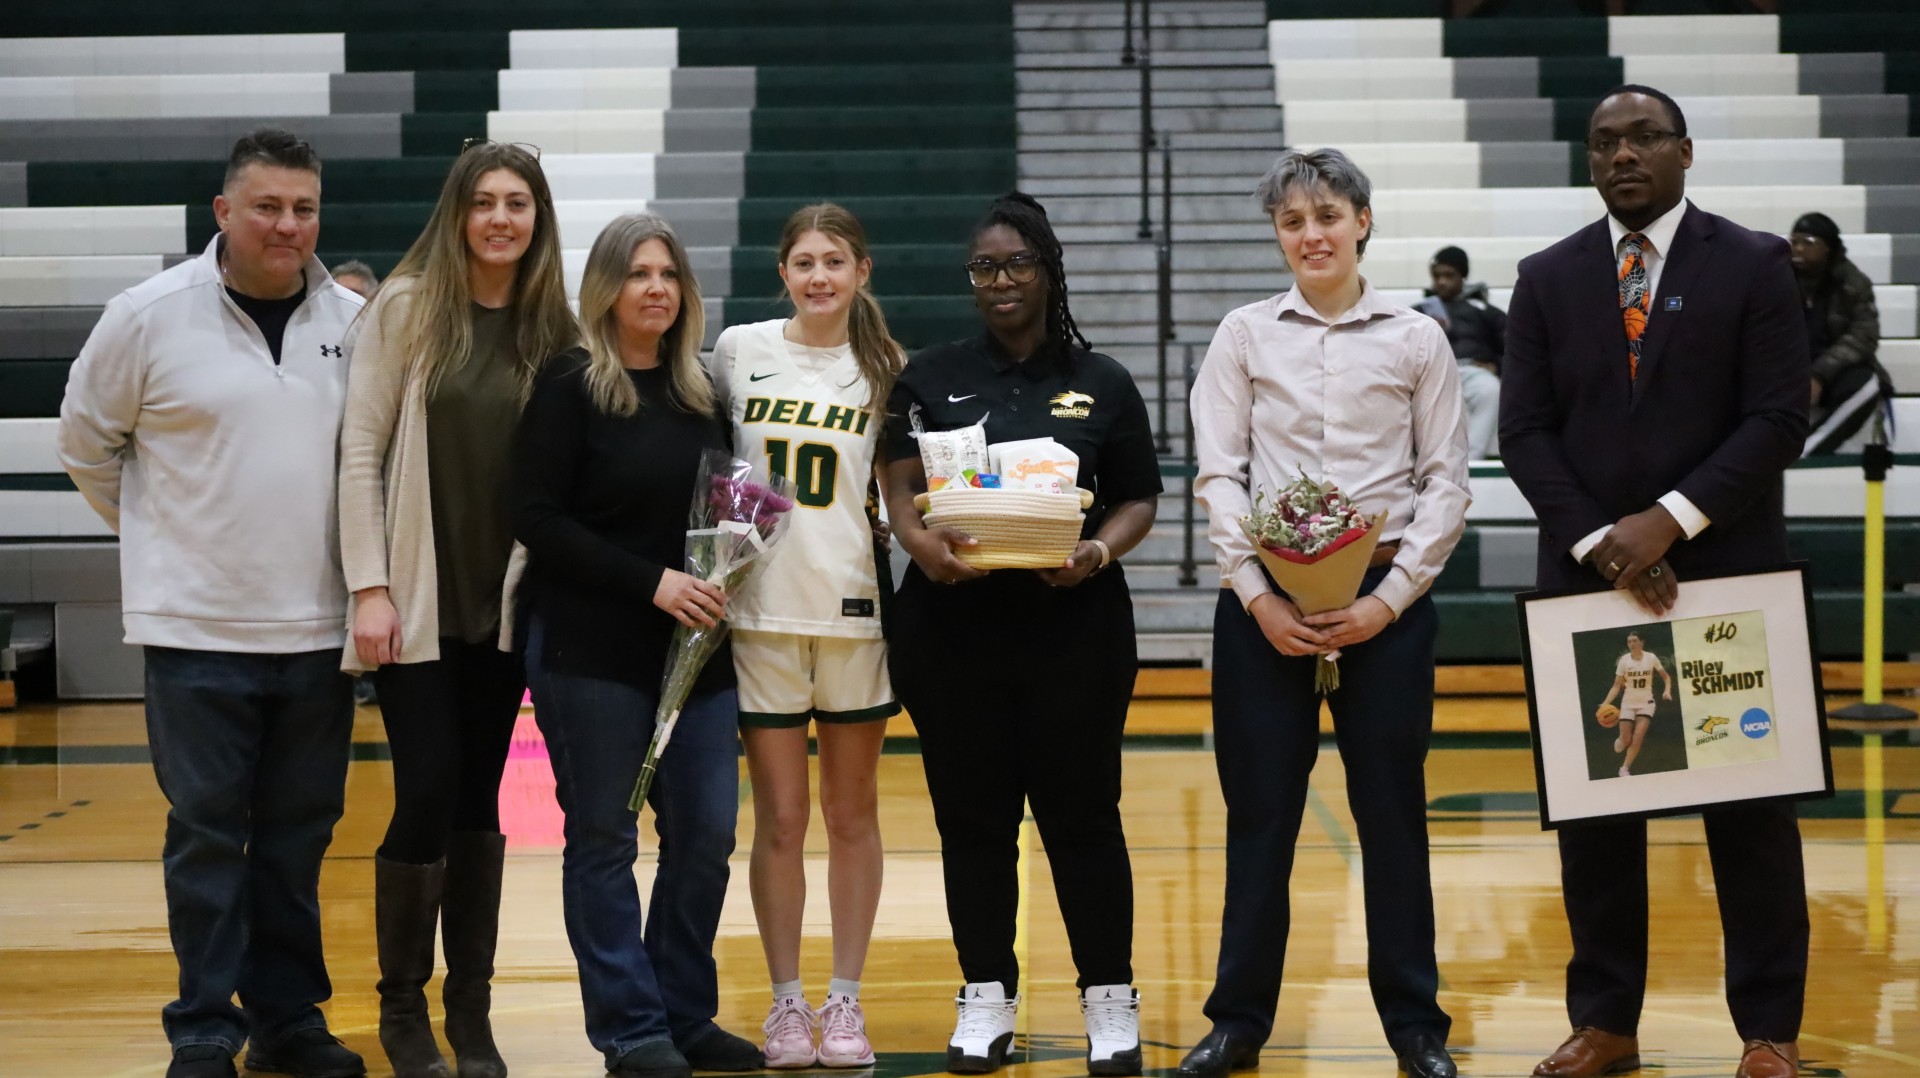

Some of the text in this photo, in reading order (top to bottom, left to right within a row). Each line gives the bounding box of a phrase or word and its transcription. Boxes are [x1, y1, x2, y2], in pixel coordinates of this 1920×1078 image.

[743, 397, 872, 437] DELHI
[764, 437, 840, 509] 10
[1704, 621, 1737, 643] #10
[1681, 660, 1724, 679] Riley
[1632, 678, 1647, 689] 10
[1692, 671, 1764, 695] SCHMIDT
[1743, 721, 1770, 733] NCAA
[1695, 731, 1728, 746] BRONCOS
